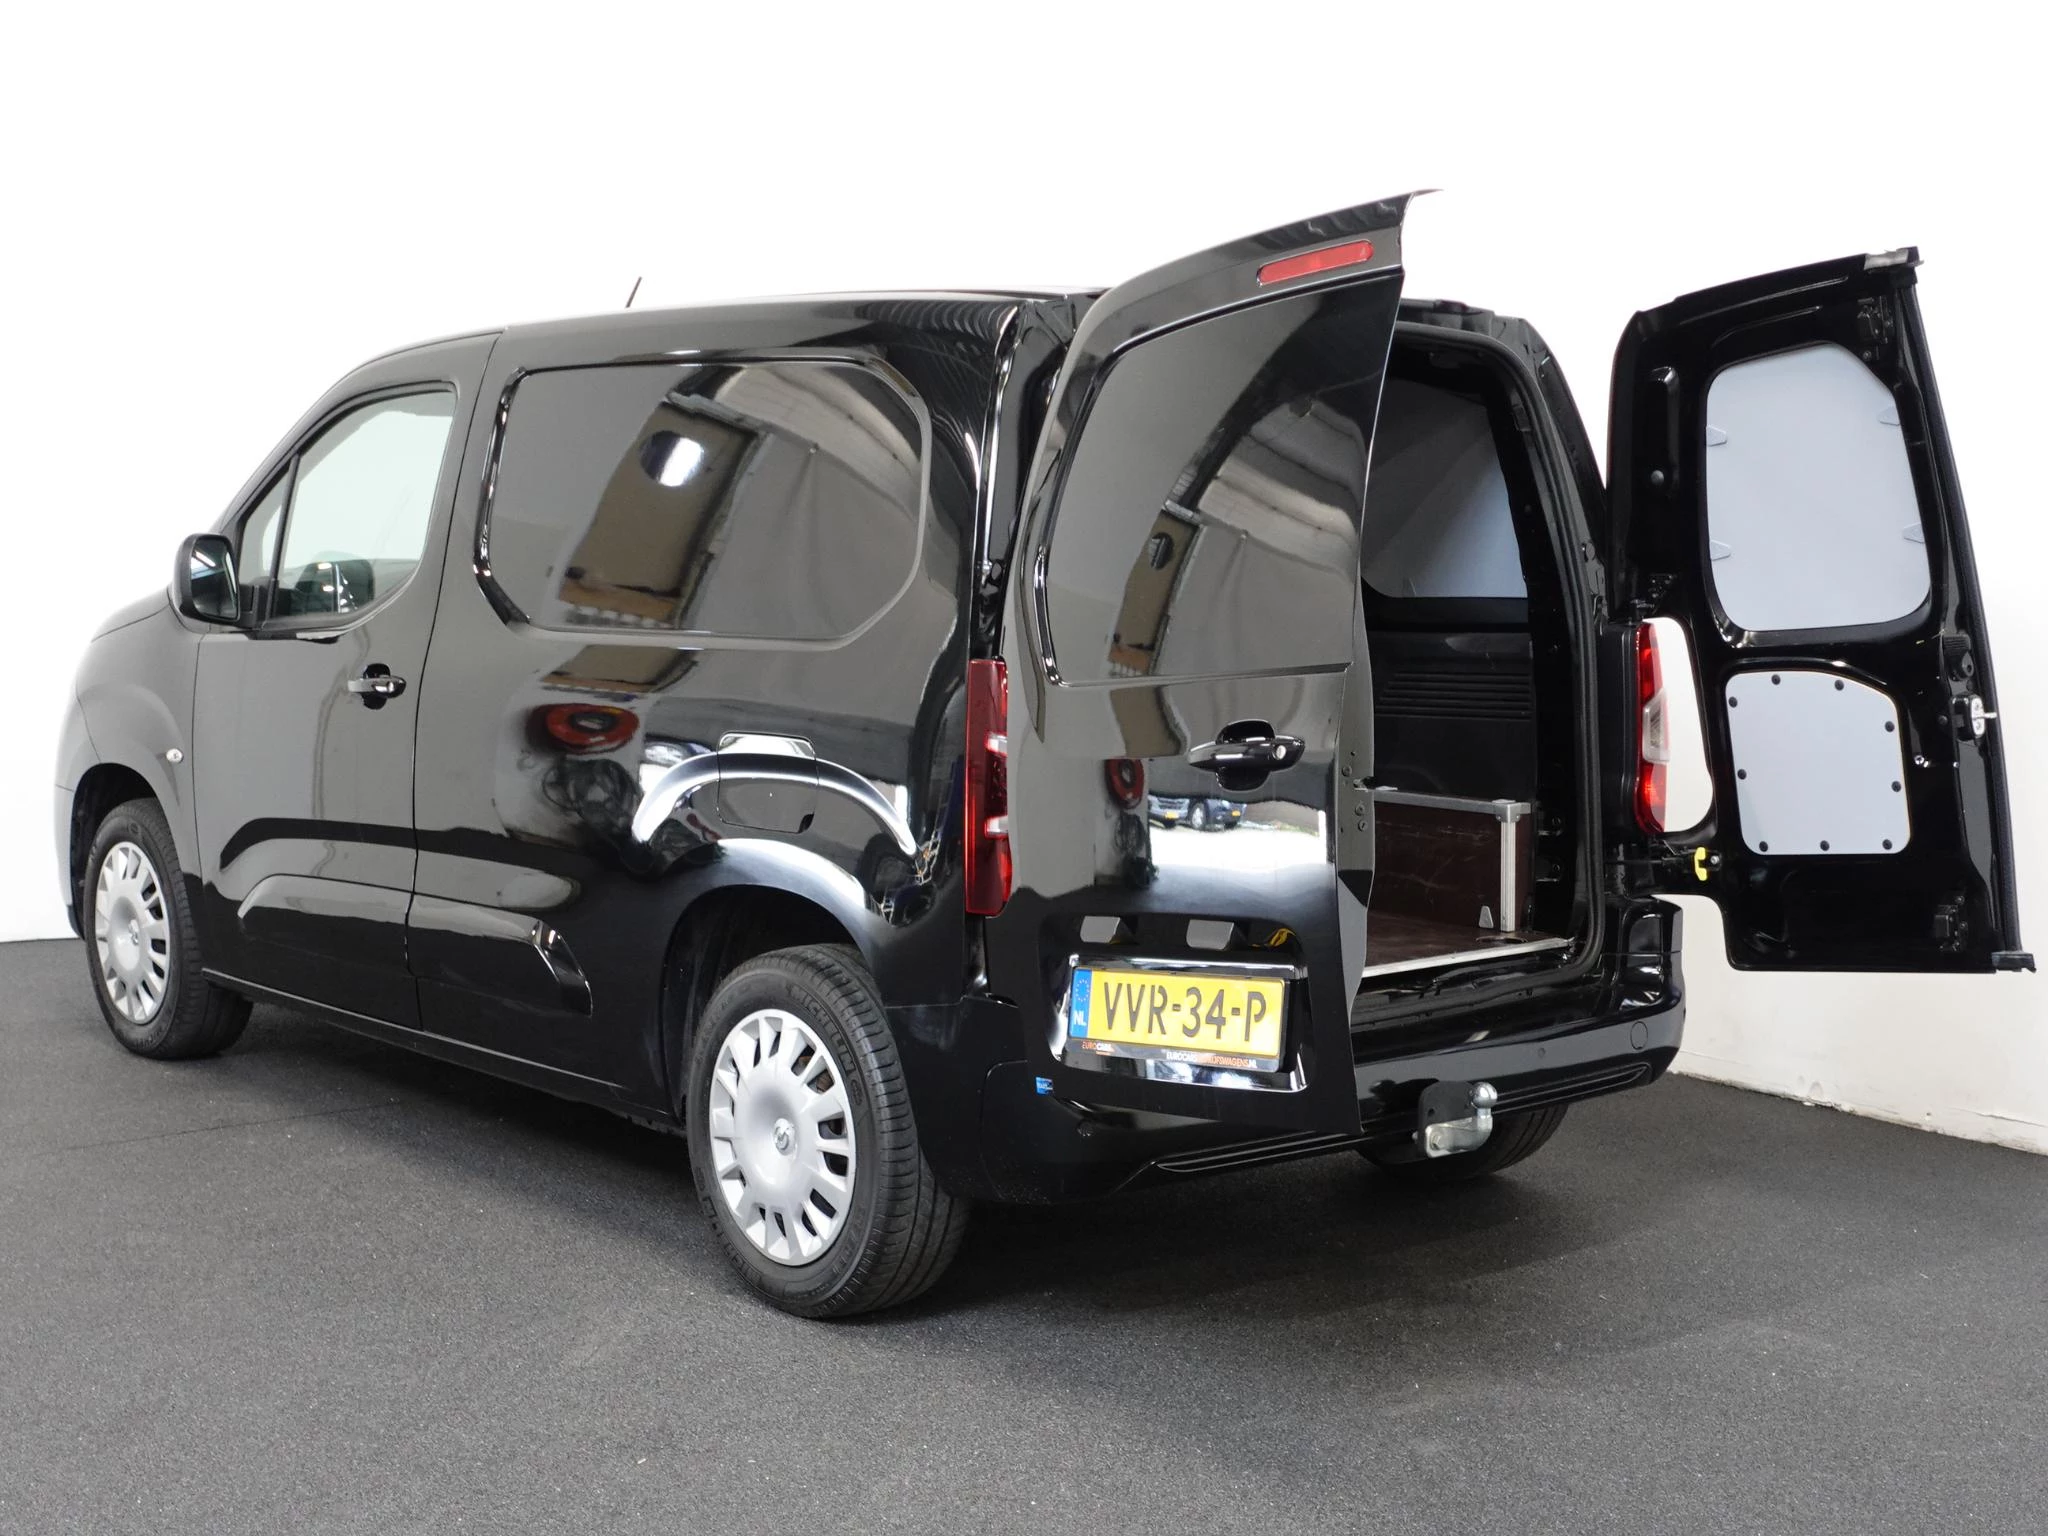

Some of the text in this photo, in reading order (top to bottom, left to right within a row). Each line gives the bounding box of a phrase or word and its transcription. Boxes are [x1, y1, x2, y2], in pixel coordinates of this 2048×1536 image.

[786, 983, 858, 1075] MICHELIN
[1072, 1008, 1087, 1027] NL
[1103, 981, 1267, 1042] VVR-34-P
